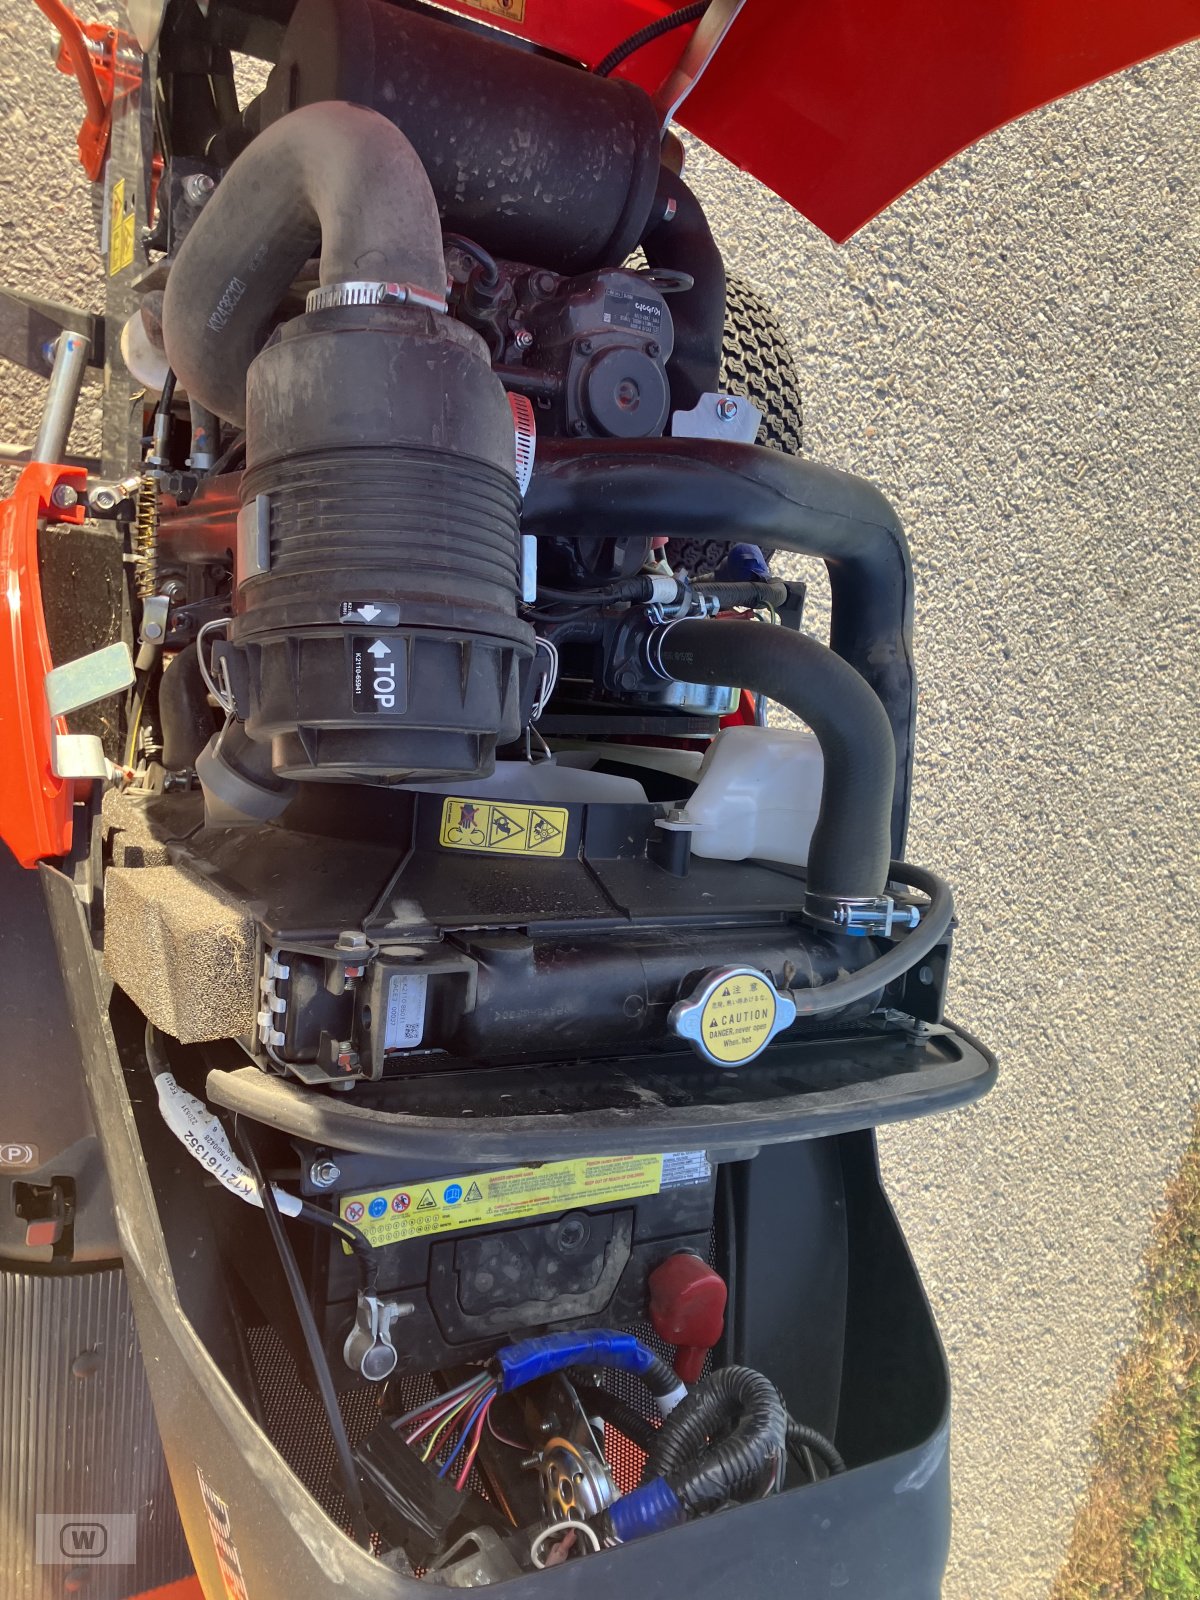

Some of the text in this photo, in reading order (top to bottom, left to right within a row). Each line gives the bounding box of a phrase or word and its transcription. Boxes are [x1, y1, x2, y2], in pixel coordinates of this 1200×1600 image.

[635, 302, 660, 316] Kubota
[373, 663, 396, 708] TOP
[721, 1008, 768, 1026] CAUTION
[8, 1147, 21, 1161] P
[184, 1130, 253, 1196] K121161352
